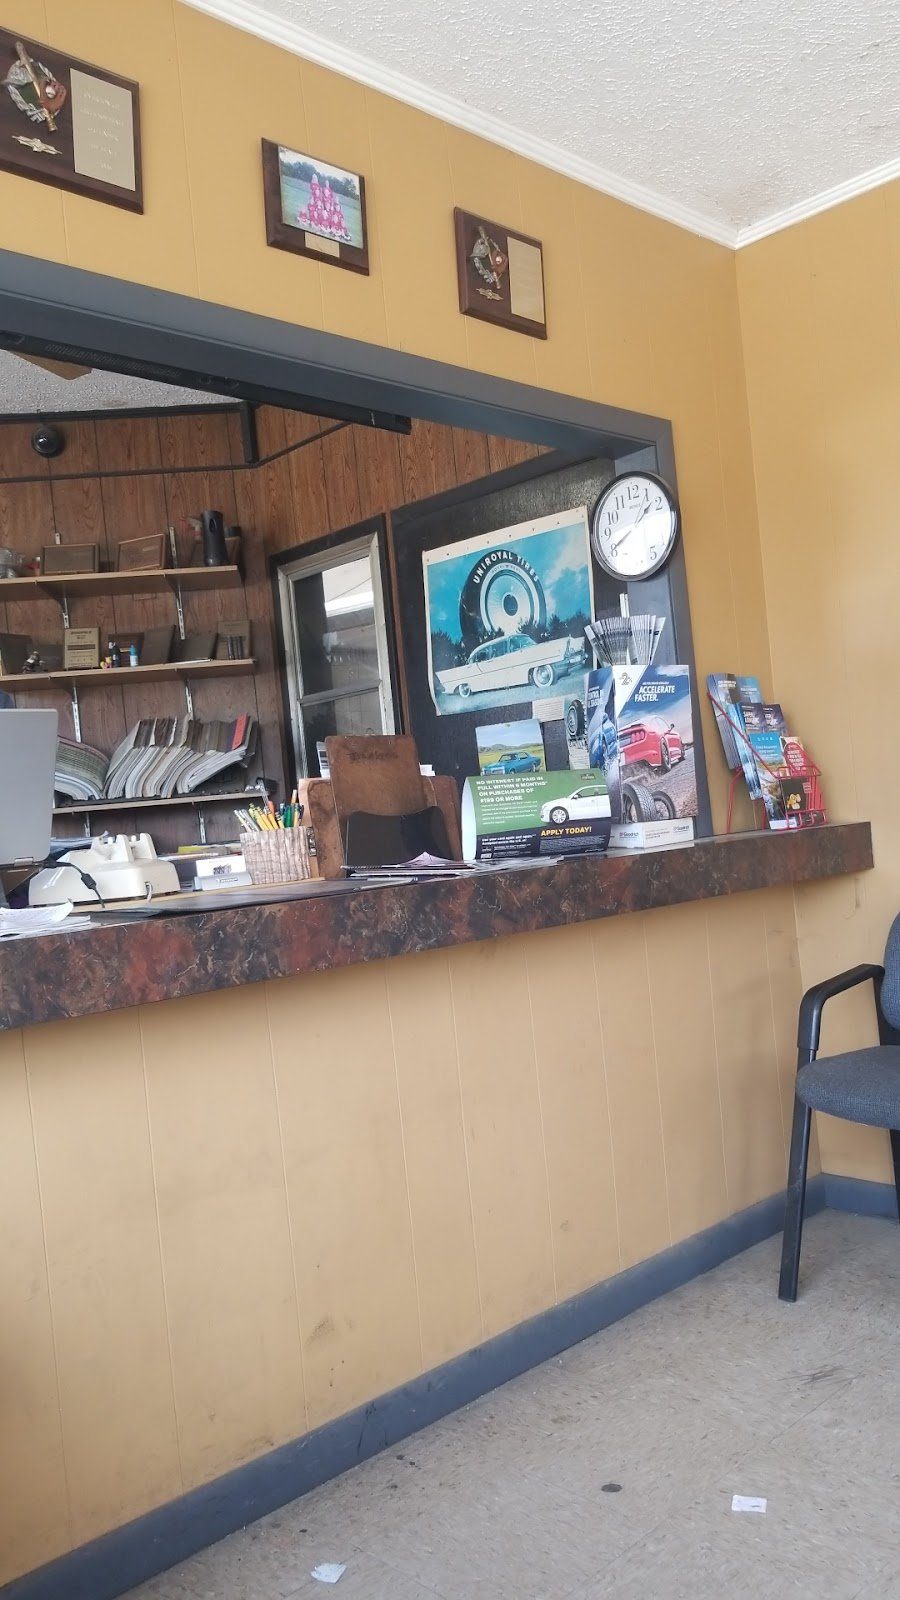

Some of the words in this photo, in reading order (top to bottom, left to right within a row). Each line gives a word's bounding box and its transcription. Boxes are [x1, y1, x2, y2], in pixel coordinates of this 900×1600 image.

[626, 484, 640, 500] 12
[644, 488, 650, 502] 1
[615, 495, 625, 510] 11
[655, 496, 663, 511] 2
[608, 511, 619, 525] 10
[604, 527, 612, 541] 9
[610, 544, 618, 558] 8
[649, 546, 658, 560] 5
[473, 552, 513, 584] UNIROYAL
[516, 556, 539, 582] TIRES
[638, 686, 675, 694] ACCELERATE
[634, 694, 659, 702] FASTER.
[541, 828, 564, 836] APPLY
